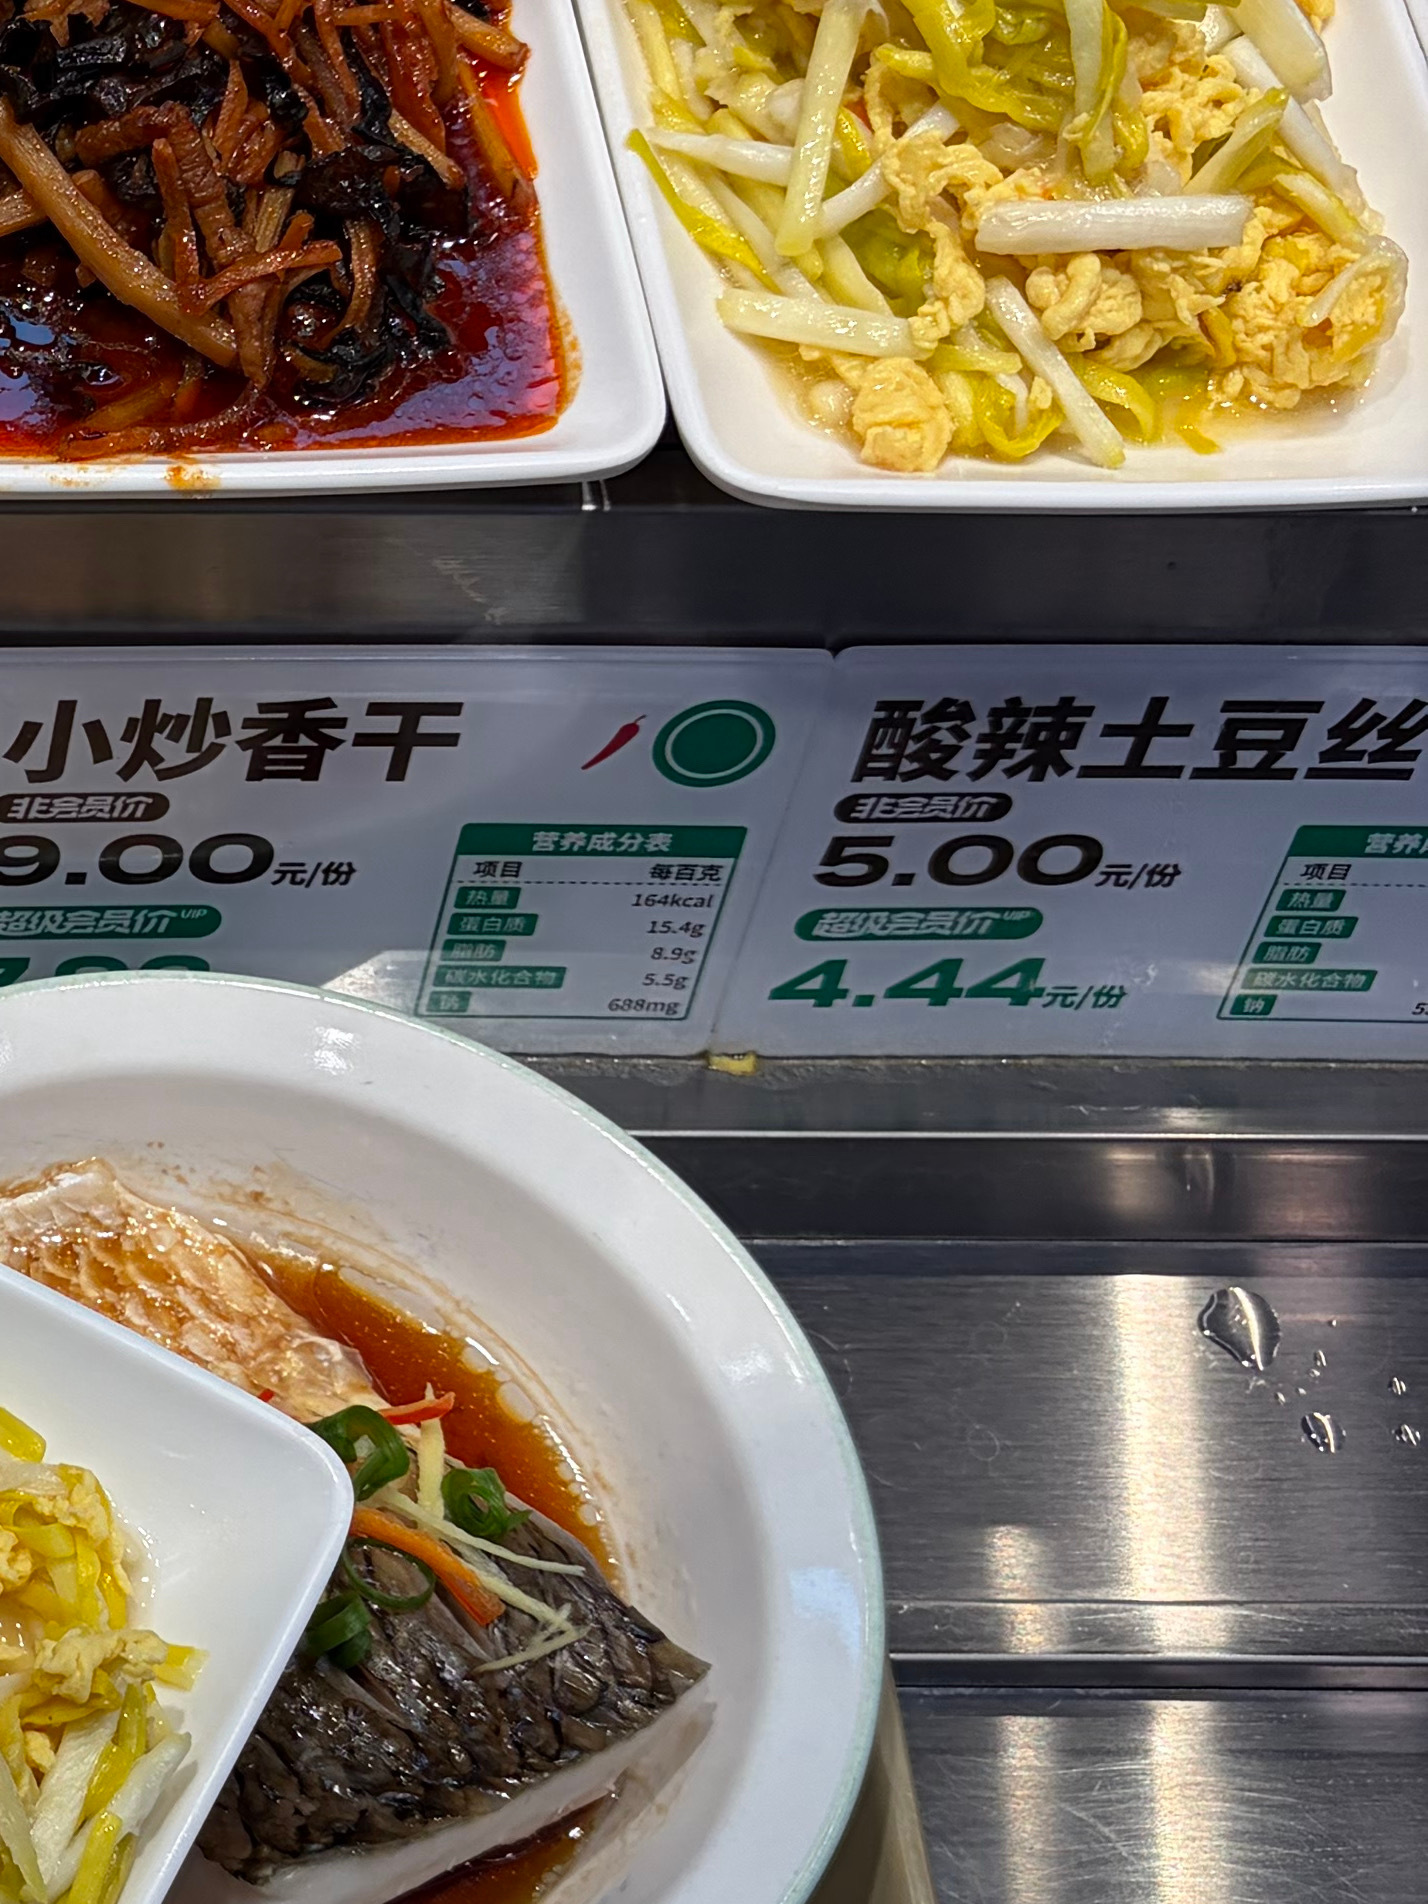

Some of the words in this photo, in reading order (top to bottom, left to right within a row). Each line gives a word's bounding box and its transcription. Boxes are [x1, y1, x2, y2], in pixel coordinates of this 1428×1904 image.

[3, 697, 464, 783] 小炒香干
[851, 696, 1428, 782] 酸辣土豆丝
[7, 795, 153, 819] 非会员价
[852, 797, 997, 820] 非会员价
[532, 831, 673, 852] 营养成分表
[1365, 832, 1428, 854] 营养
[474, 860, 522, 879] 项目
[649, 862, 723, 883] 每百克
[1300, 863, 1352, 881] 项目
[632, 891, 713, 909] 164kcal
[646, 918, 706, 939] 15.4g
[650, 945, 697, 965] 8.9g
[642, 971, 689, 990] 5.5g
[608, 997, 680, 1016] 688mg
